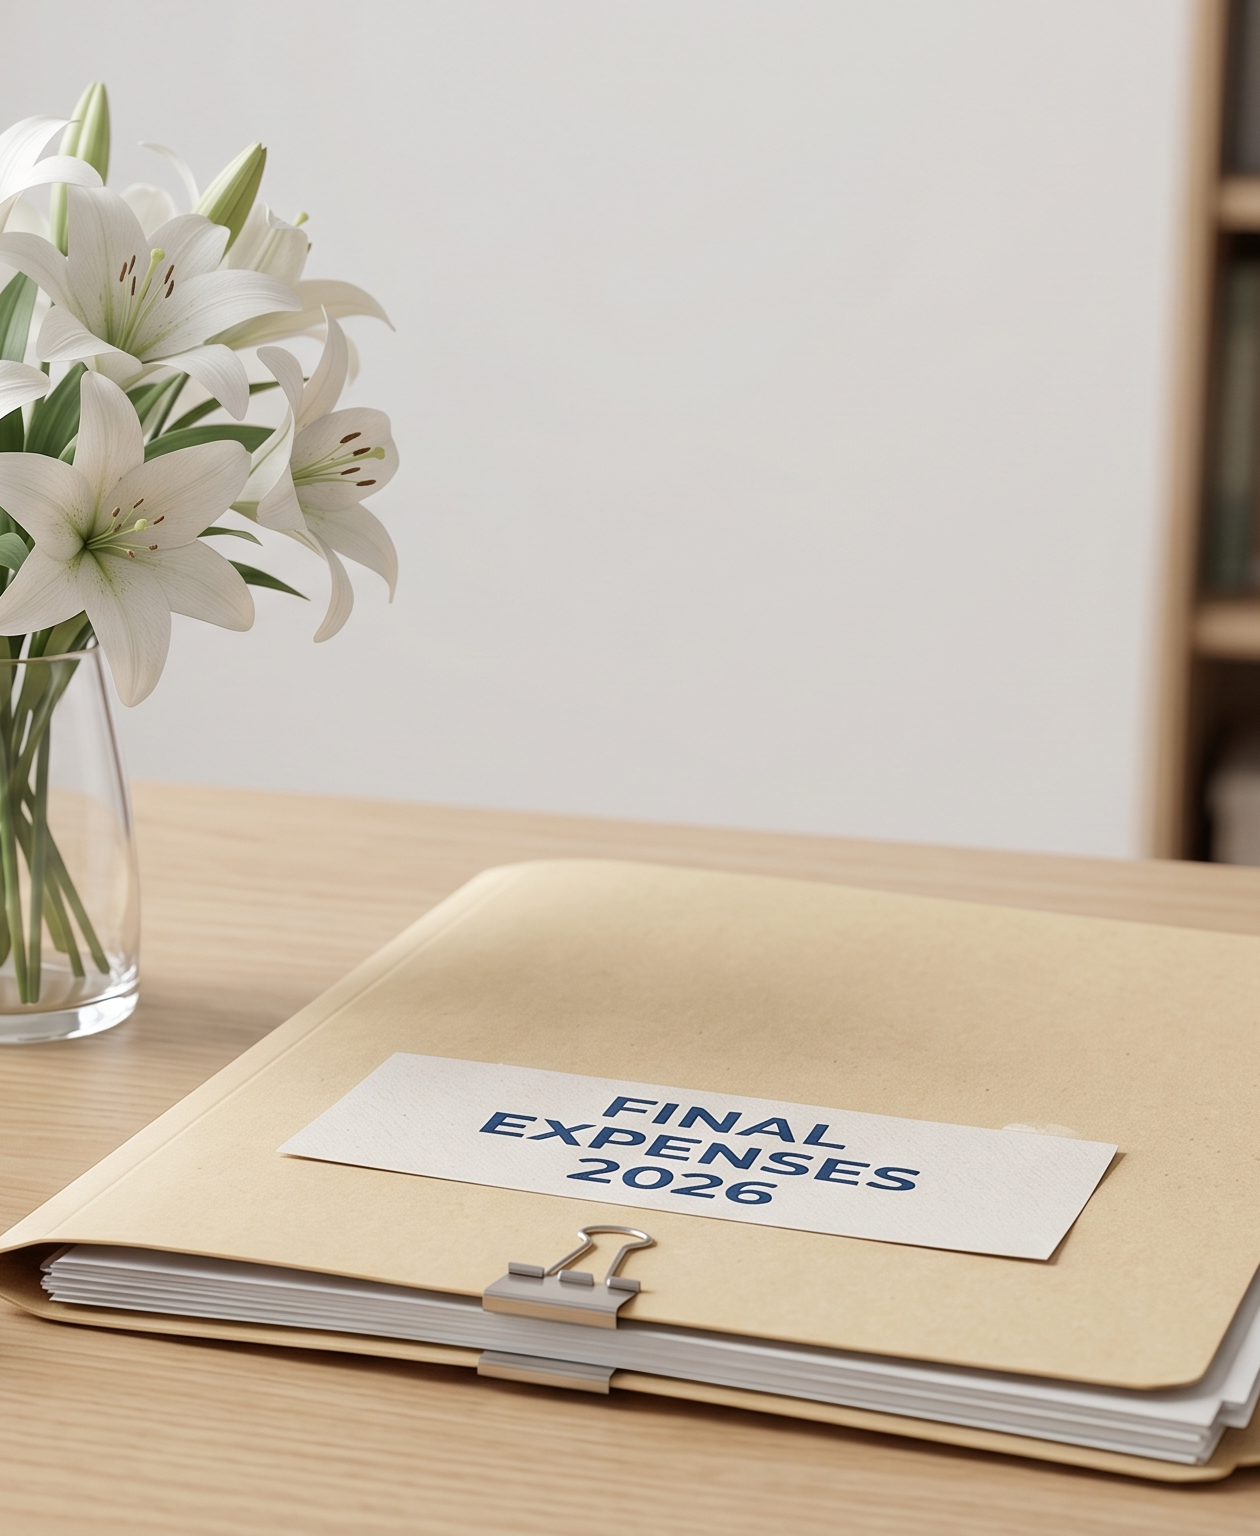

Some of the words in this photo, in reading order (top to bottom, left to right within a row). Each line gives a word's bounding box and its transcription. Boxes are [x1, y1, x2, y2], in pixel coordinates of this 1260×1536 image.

[602, 1095, 846, 1150] FINAL
[479, 1111, 921, 1192] EXPENSES
[567, 1157, 773, 1206] 2026
